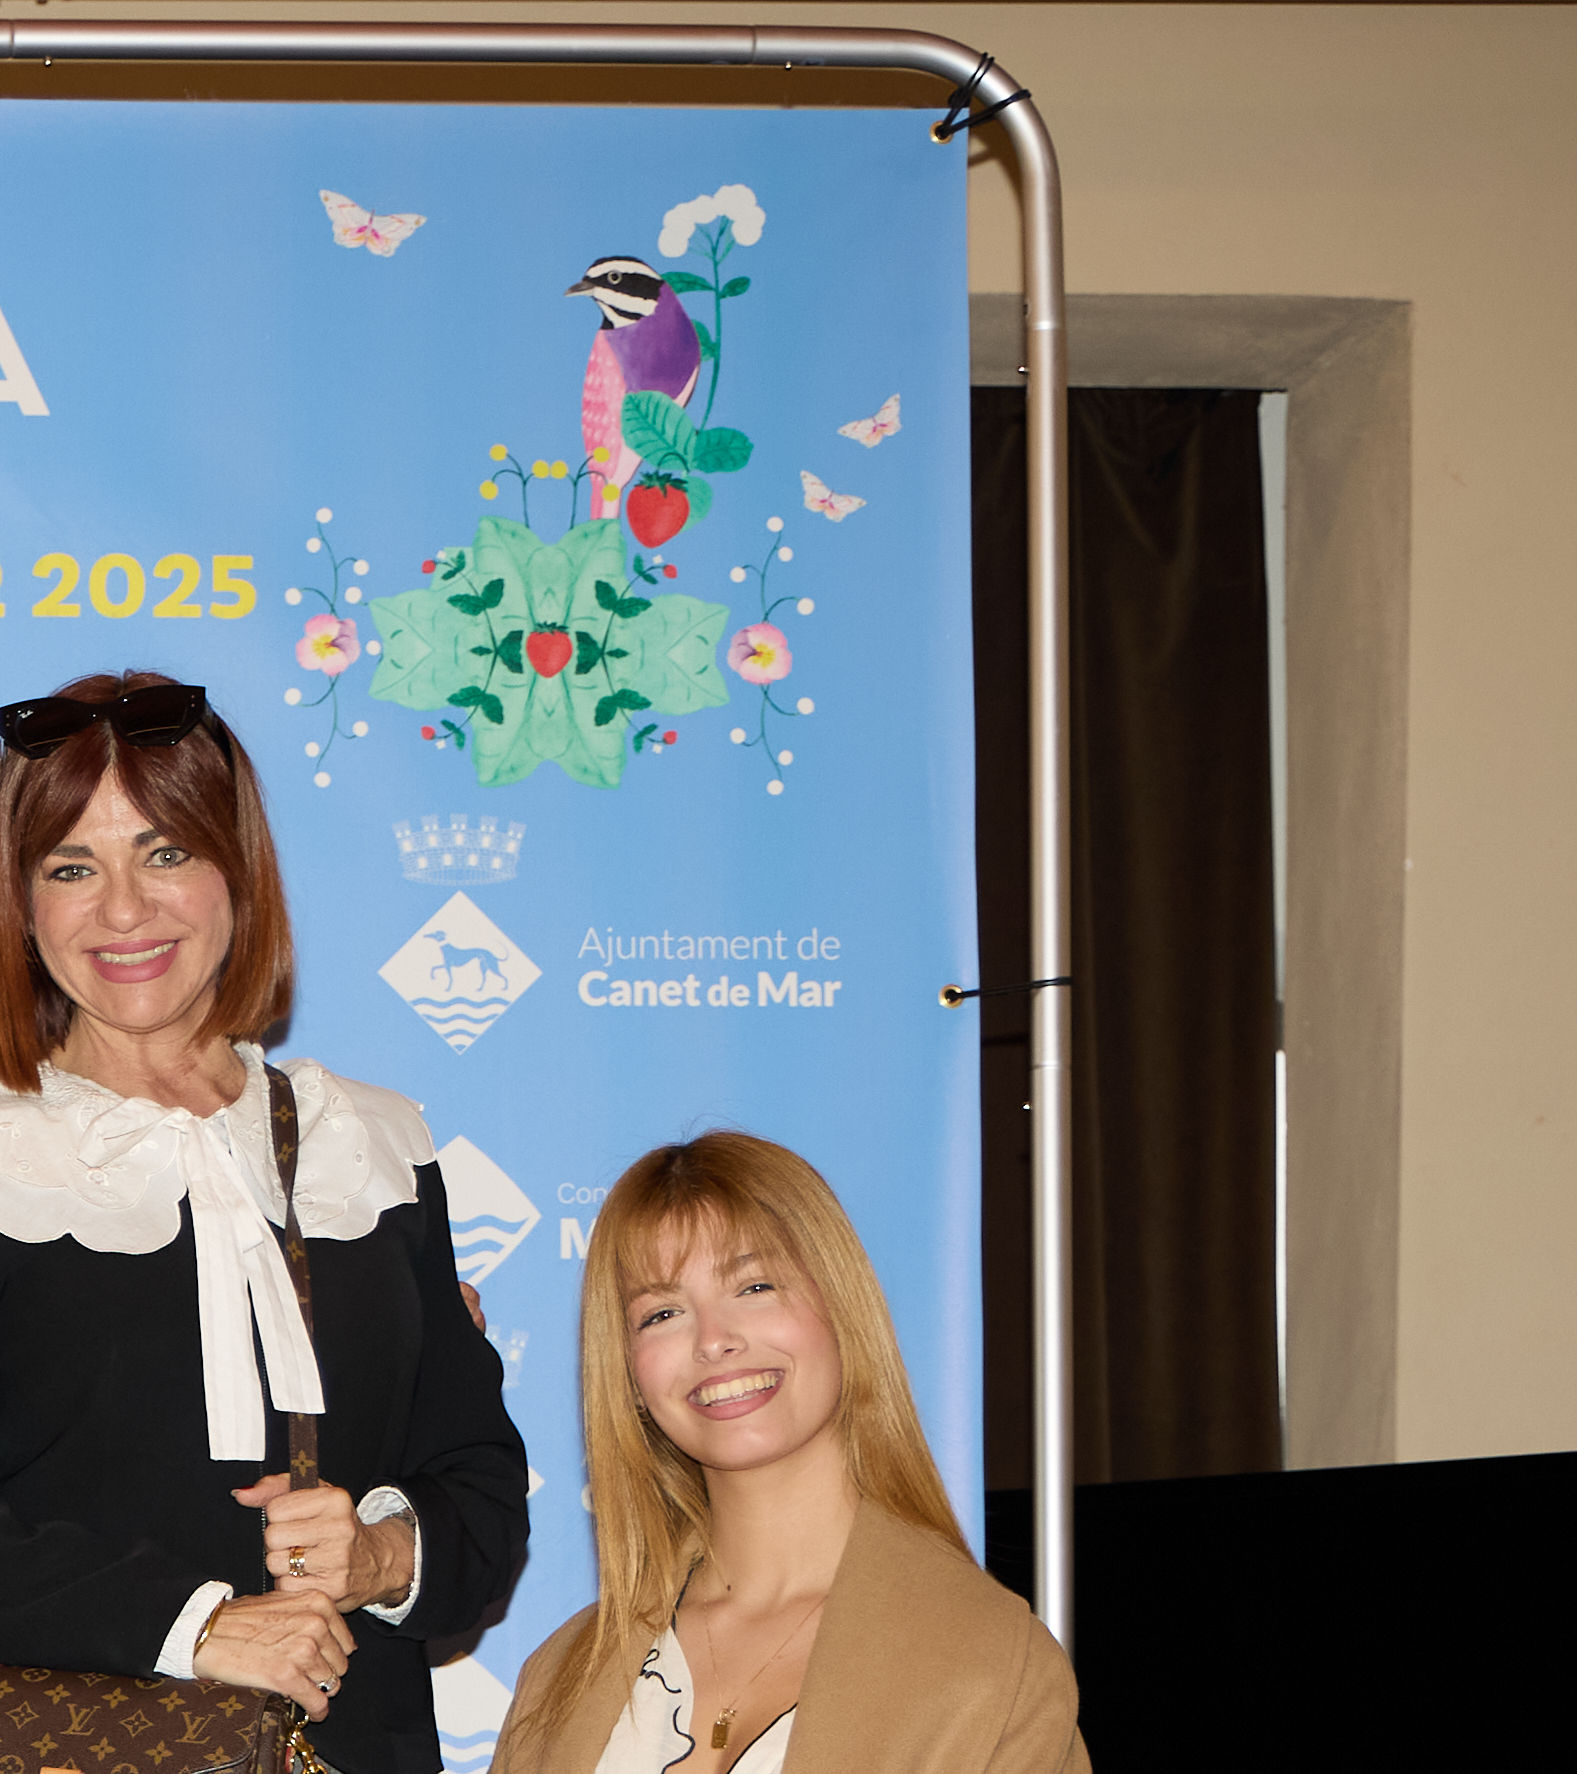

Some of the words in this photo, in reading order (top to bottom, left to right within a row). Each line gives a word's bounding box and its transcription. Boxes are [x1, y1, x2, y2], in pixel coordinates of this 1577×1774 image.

[32, 553, 257, 619] 2025
[577, 927, 788, 967] Ajuntament
[796, 927, 841, 961] de
[578, 970, 701, 1007] Canet
[707, 975, 751, 1007] de
[757, 971, 842, 1007] Mar
